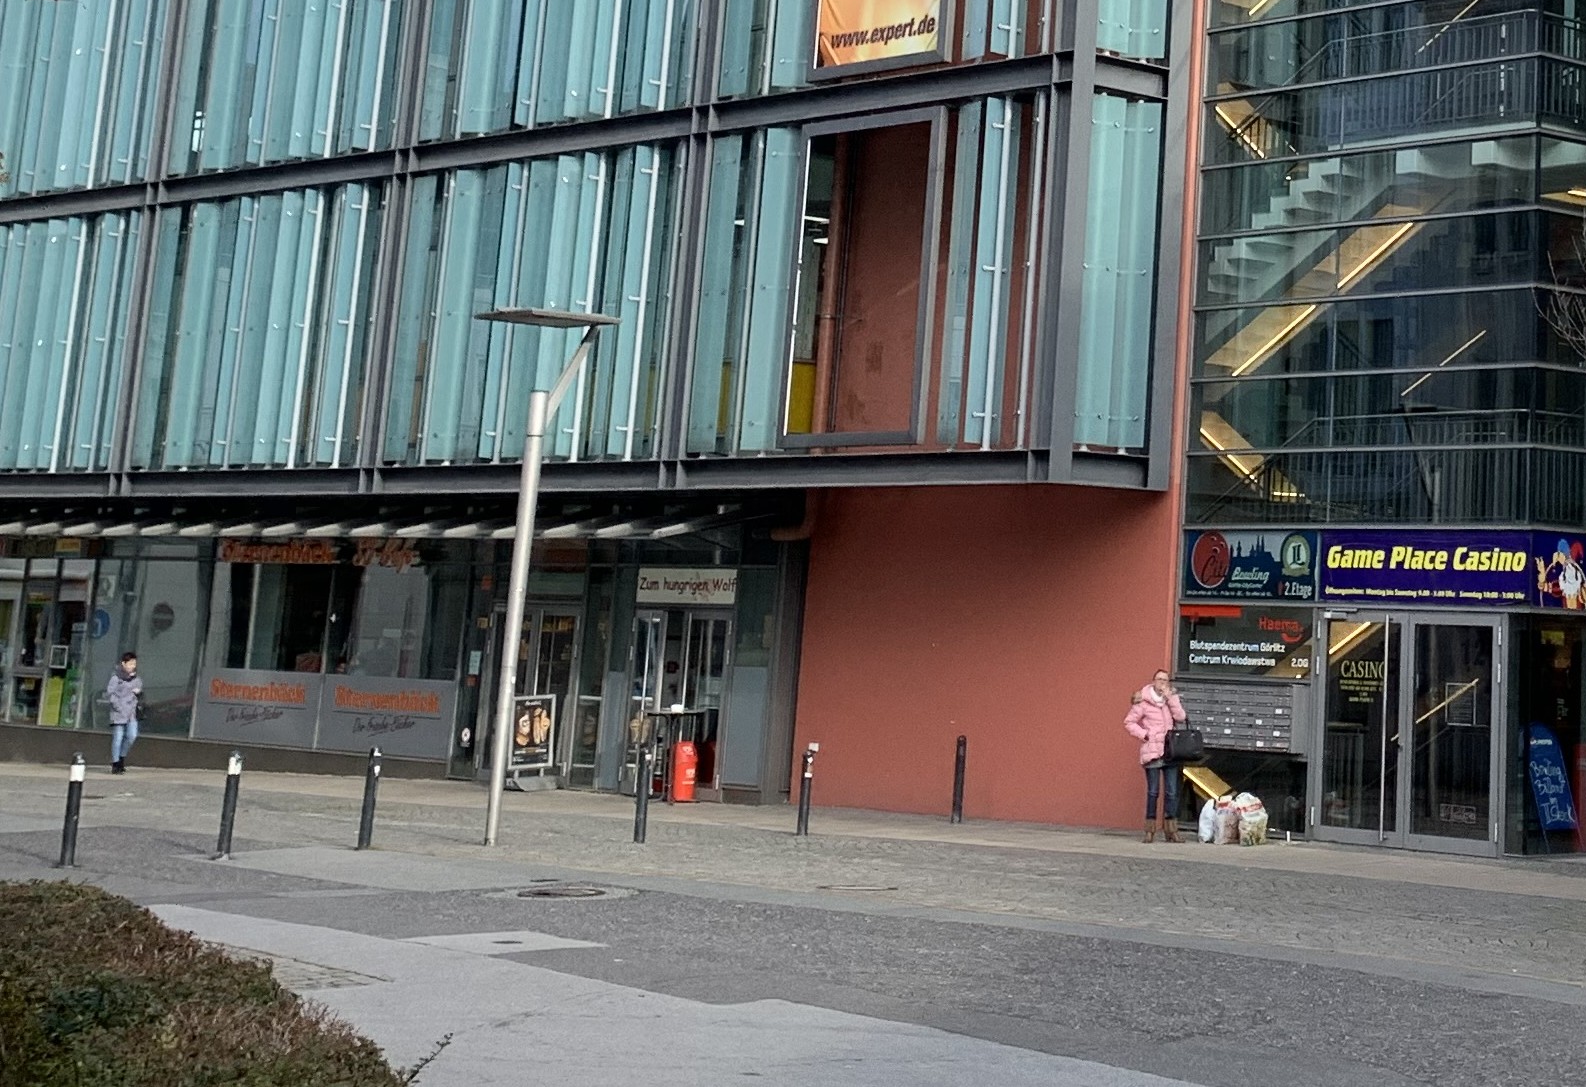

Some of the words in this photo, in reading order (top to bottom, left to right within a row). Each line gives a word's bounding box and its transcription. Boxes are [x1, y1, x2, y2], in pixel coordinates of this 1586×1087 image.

[831, 14, 936, 49] www.expert.de
[1327, 546, 1385, 569] Game
[1389, 546, 1448, 570] Place
[1453, 547, 1527, 571] Casino
[640, 577, 659, 590] Zum
[663, 577, 708, 595] hungrigen
[712, 577, 738, 592] Wolf
[1260, 642, 1286, 653] Görlitz
[1189, 654, 1221, 664] Centrum
